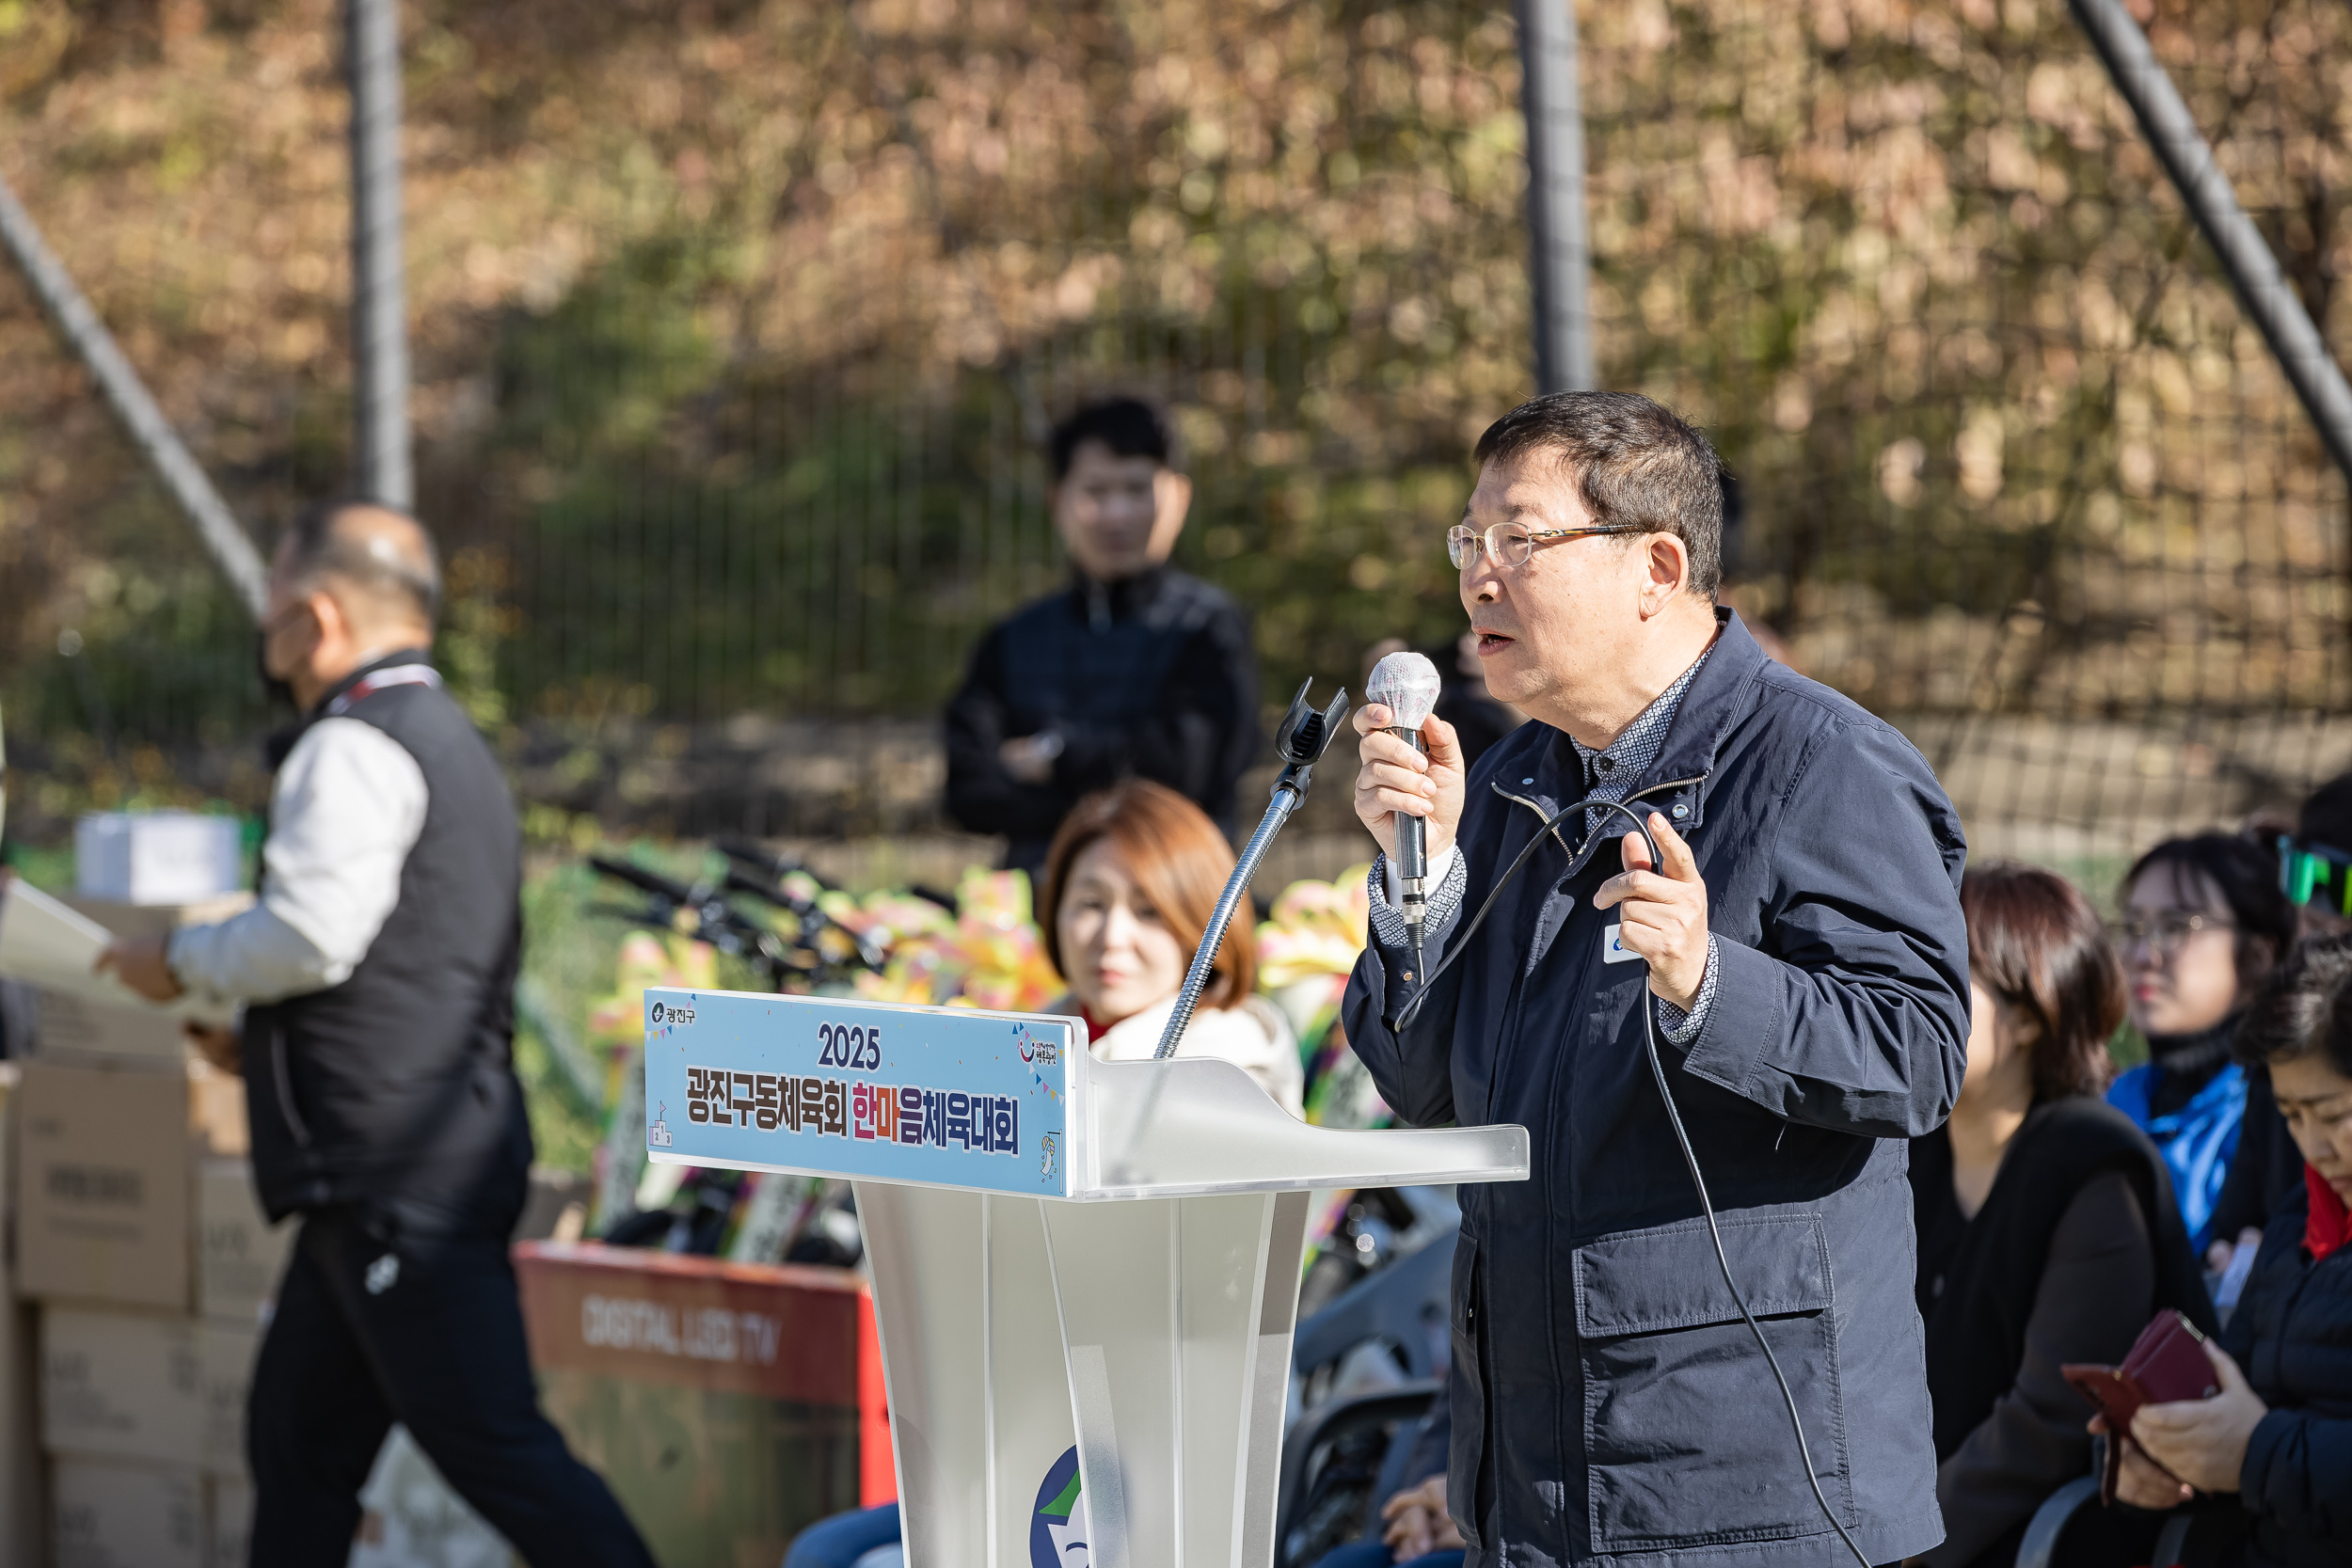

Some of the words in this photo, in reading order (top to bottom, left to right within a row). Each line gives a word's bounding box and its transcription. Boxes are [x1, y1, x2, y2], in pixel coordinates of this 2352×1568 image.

[665, 1007, 696, 1024] 광진구
[818, 1023, 881, 1070] 2025
[687, 1068, 847, 1137] 광진구동체육회
[852, 1082, 1019, 1155] 한마음체육대회
[740, 1310, 784, 1366] TV
